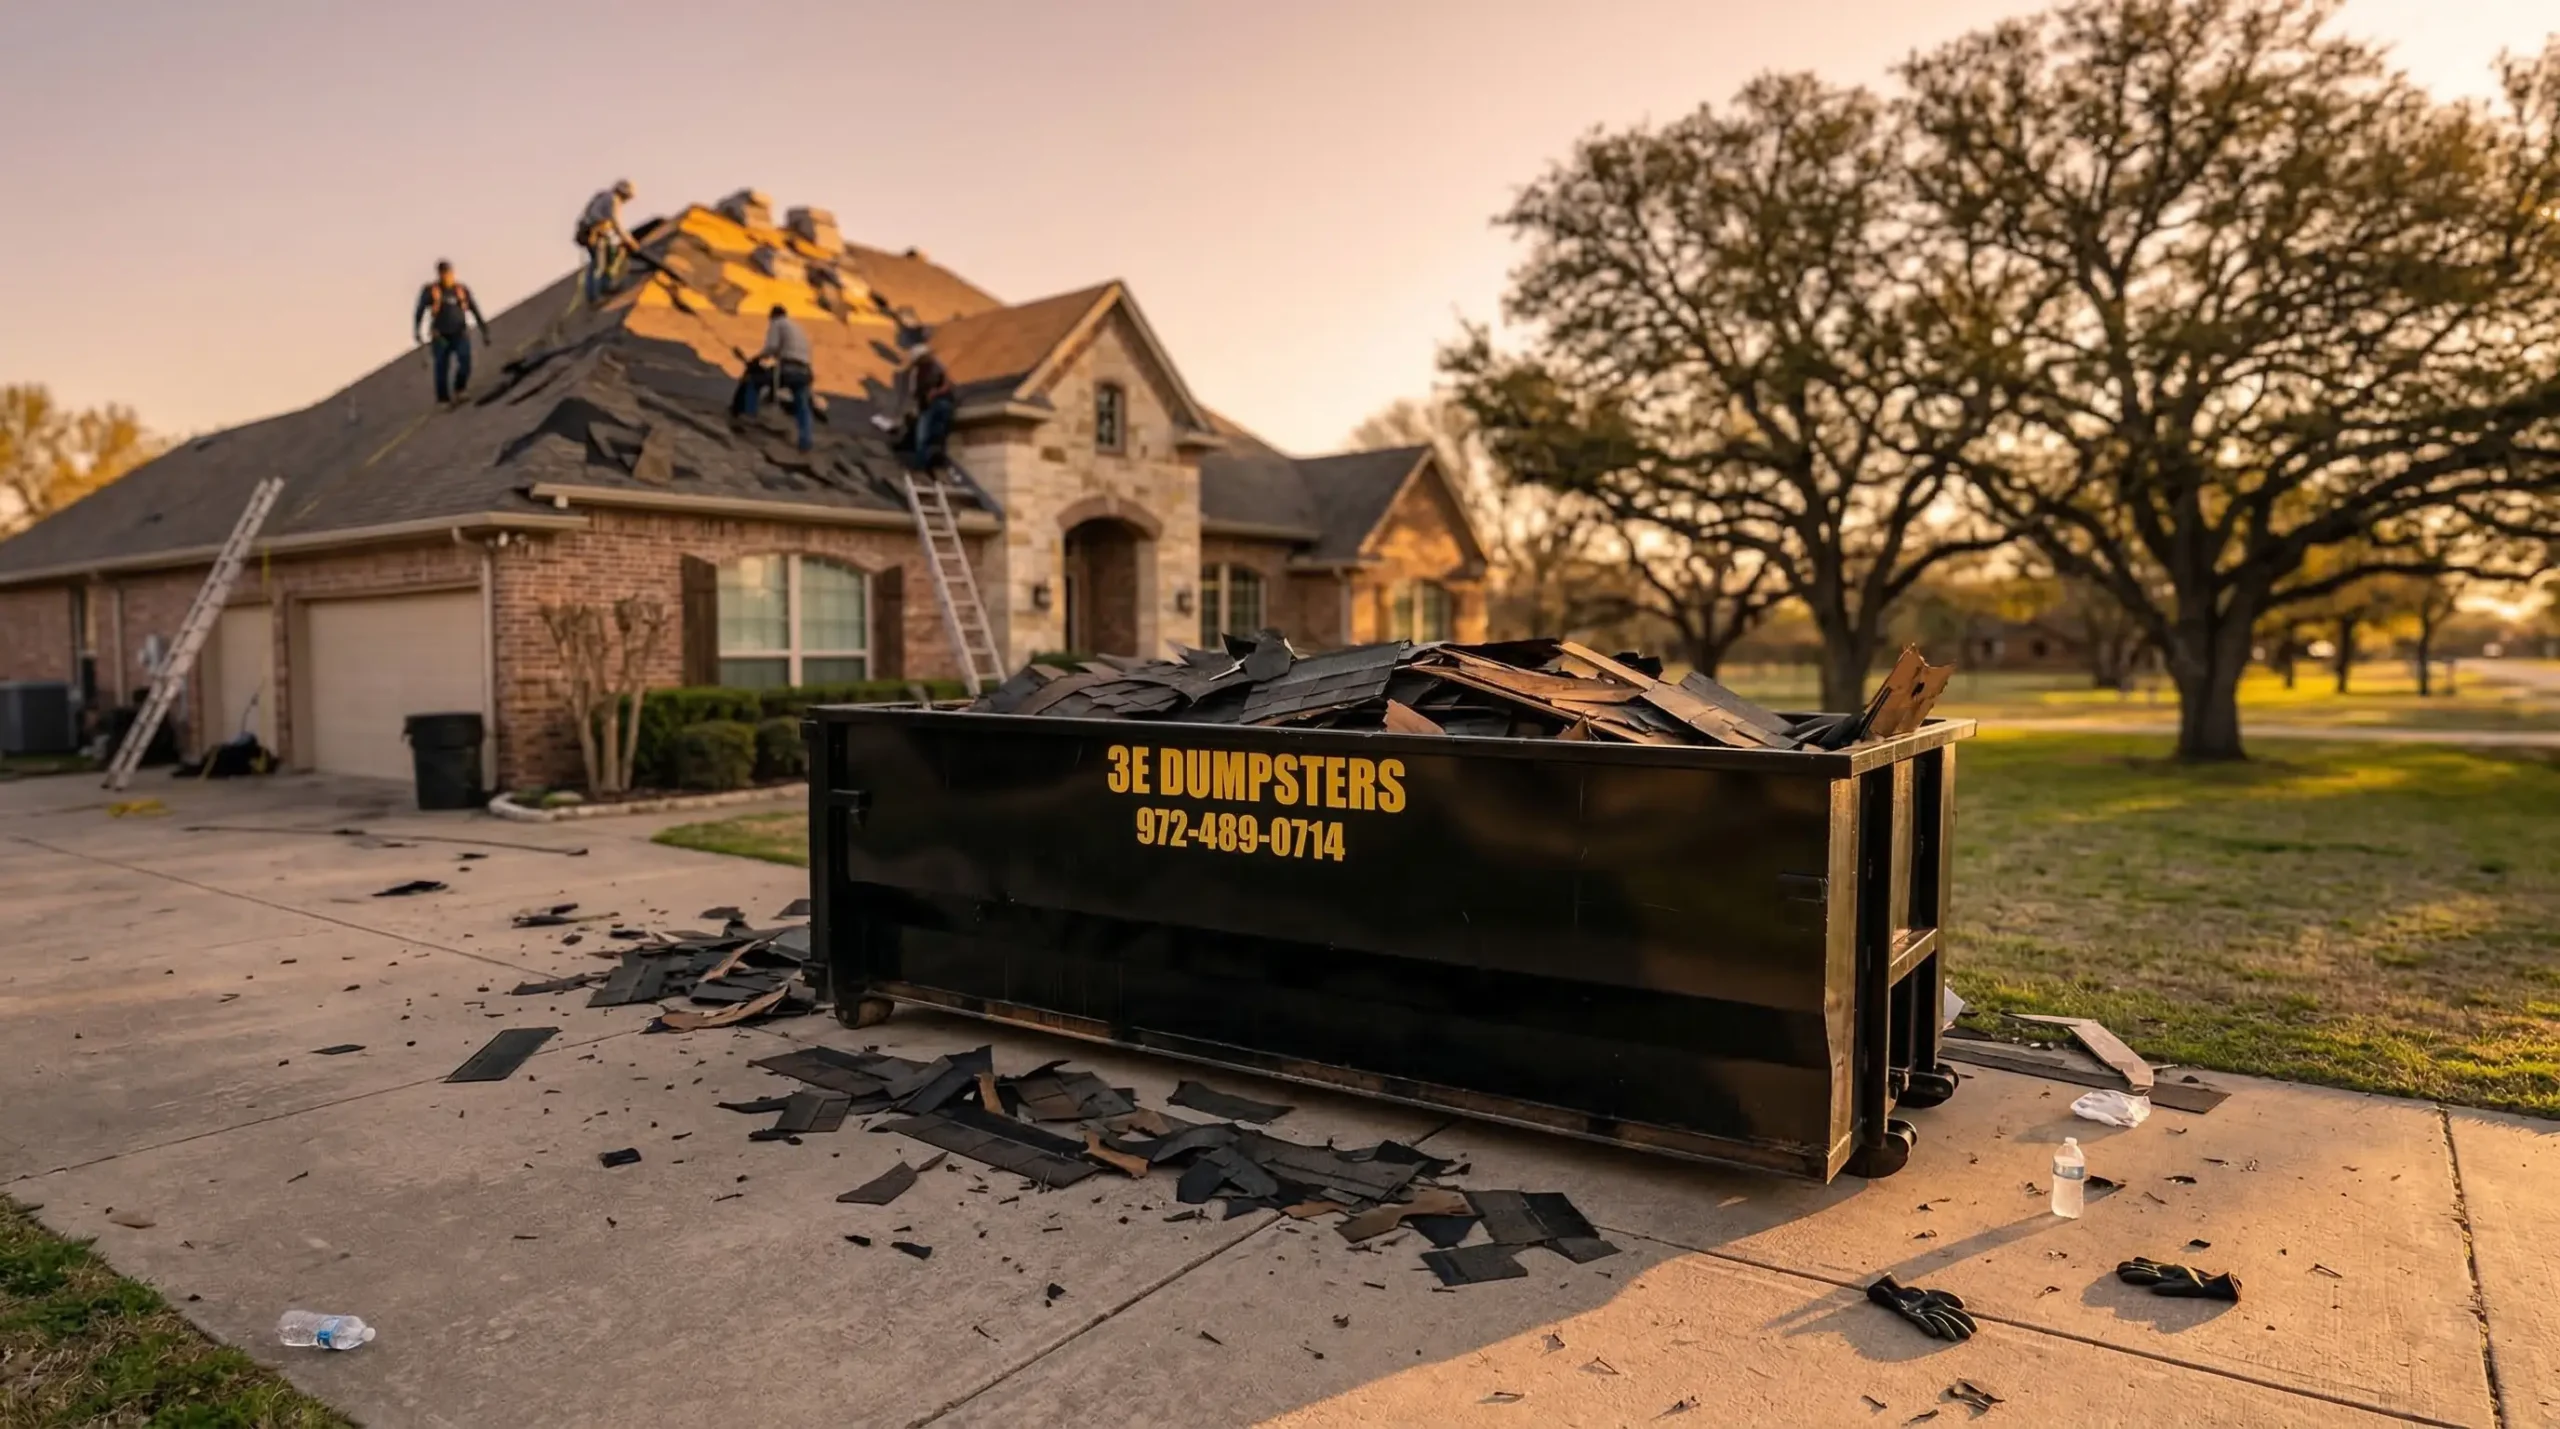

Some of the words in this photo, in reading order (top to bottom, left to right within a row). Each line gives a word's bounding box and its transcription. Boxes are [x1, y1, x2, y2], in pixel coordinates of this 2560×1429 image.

[1107, 744, 1150, 794] 3E
[1160, 747, 1406, 813] DUMPSTERS
[1136, 806, 1346, 862] 972-489-0714
